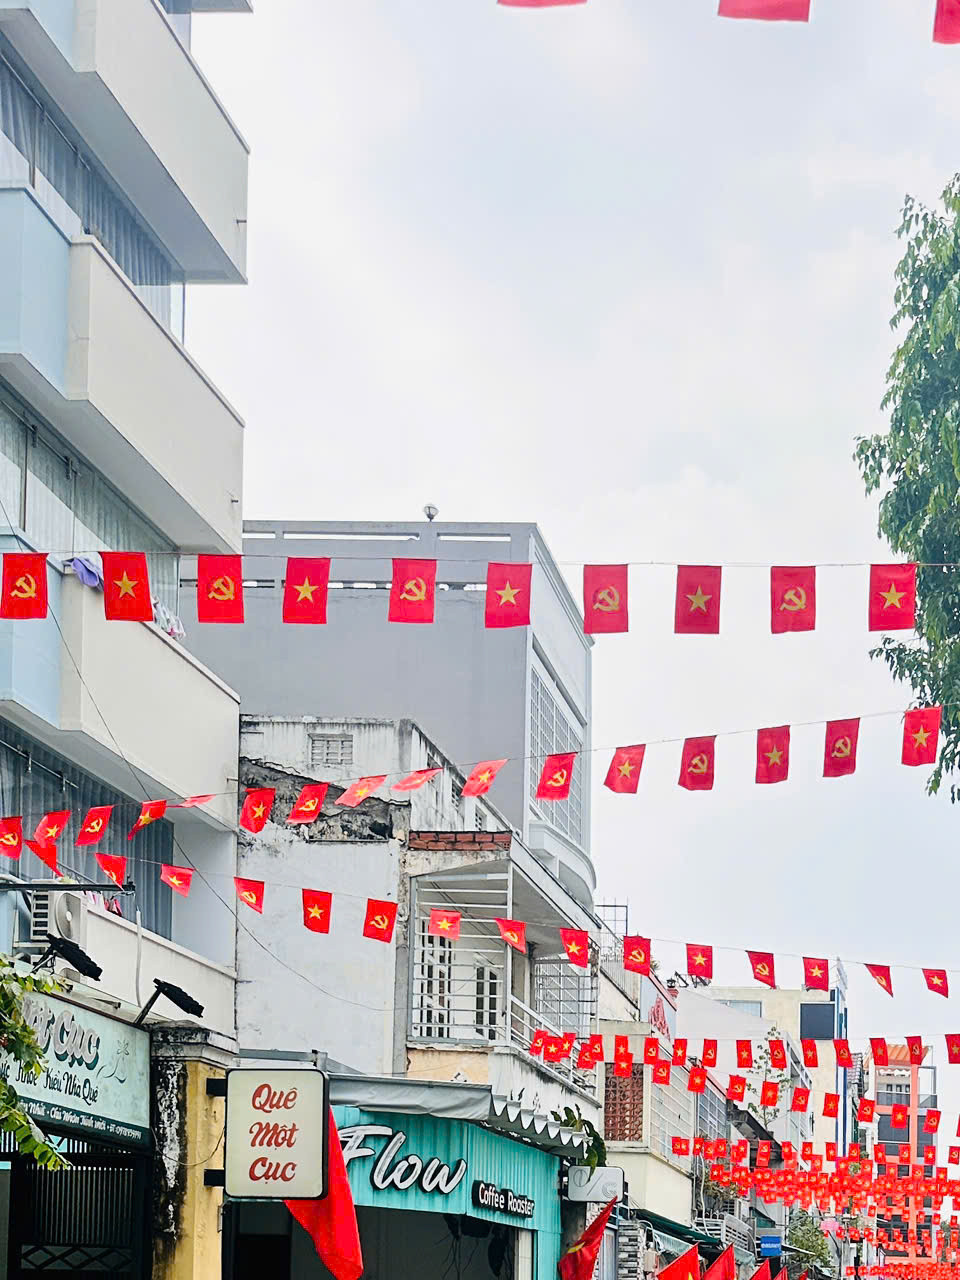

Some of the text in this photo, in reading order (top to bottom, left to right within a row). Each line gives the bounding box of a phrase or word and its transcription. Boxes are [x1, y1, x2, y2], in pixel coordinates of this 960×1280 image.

[82, 1078, 99, 1105] Quê
[251, 1083, 298, 1114] Quê
[248, 1121, 299, 1151] Một
[248, 1156, 297, 1184] Cục
[337, 1124, 467, 1194] Flow
[478, 1182, 535, 1216] Coffee Roaster
